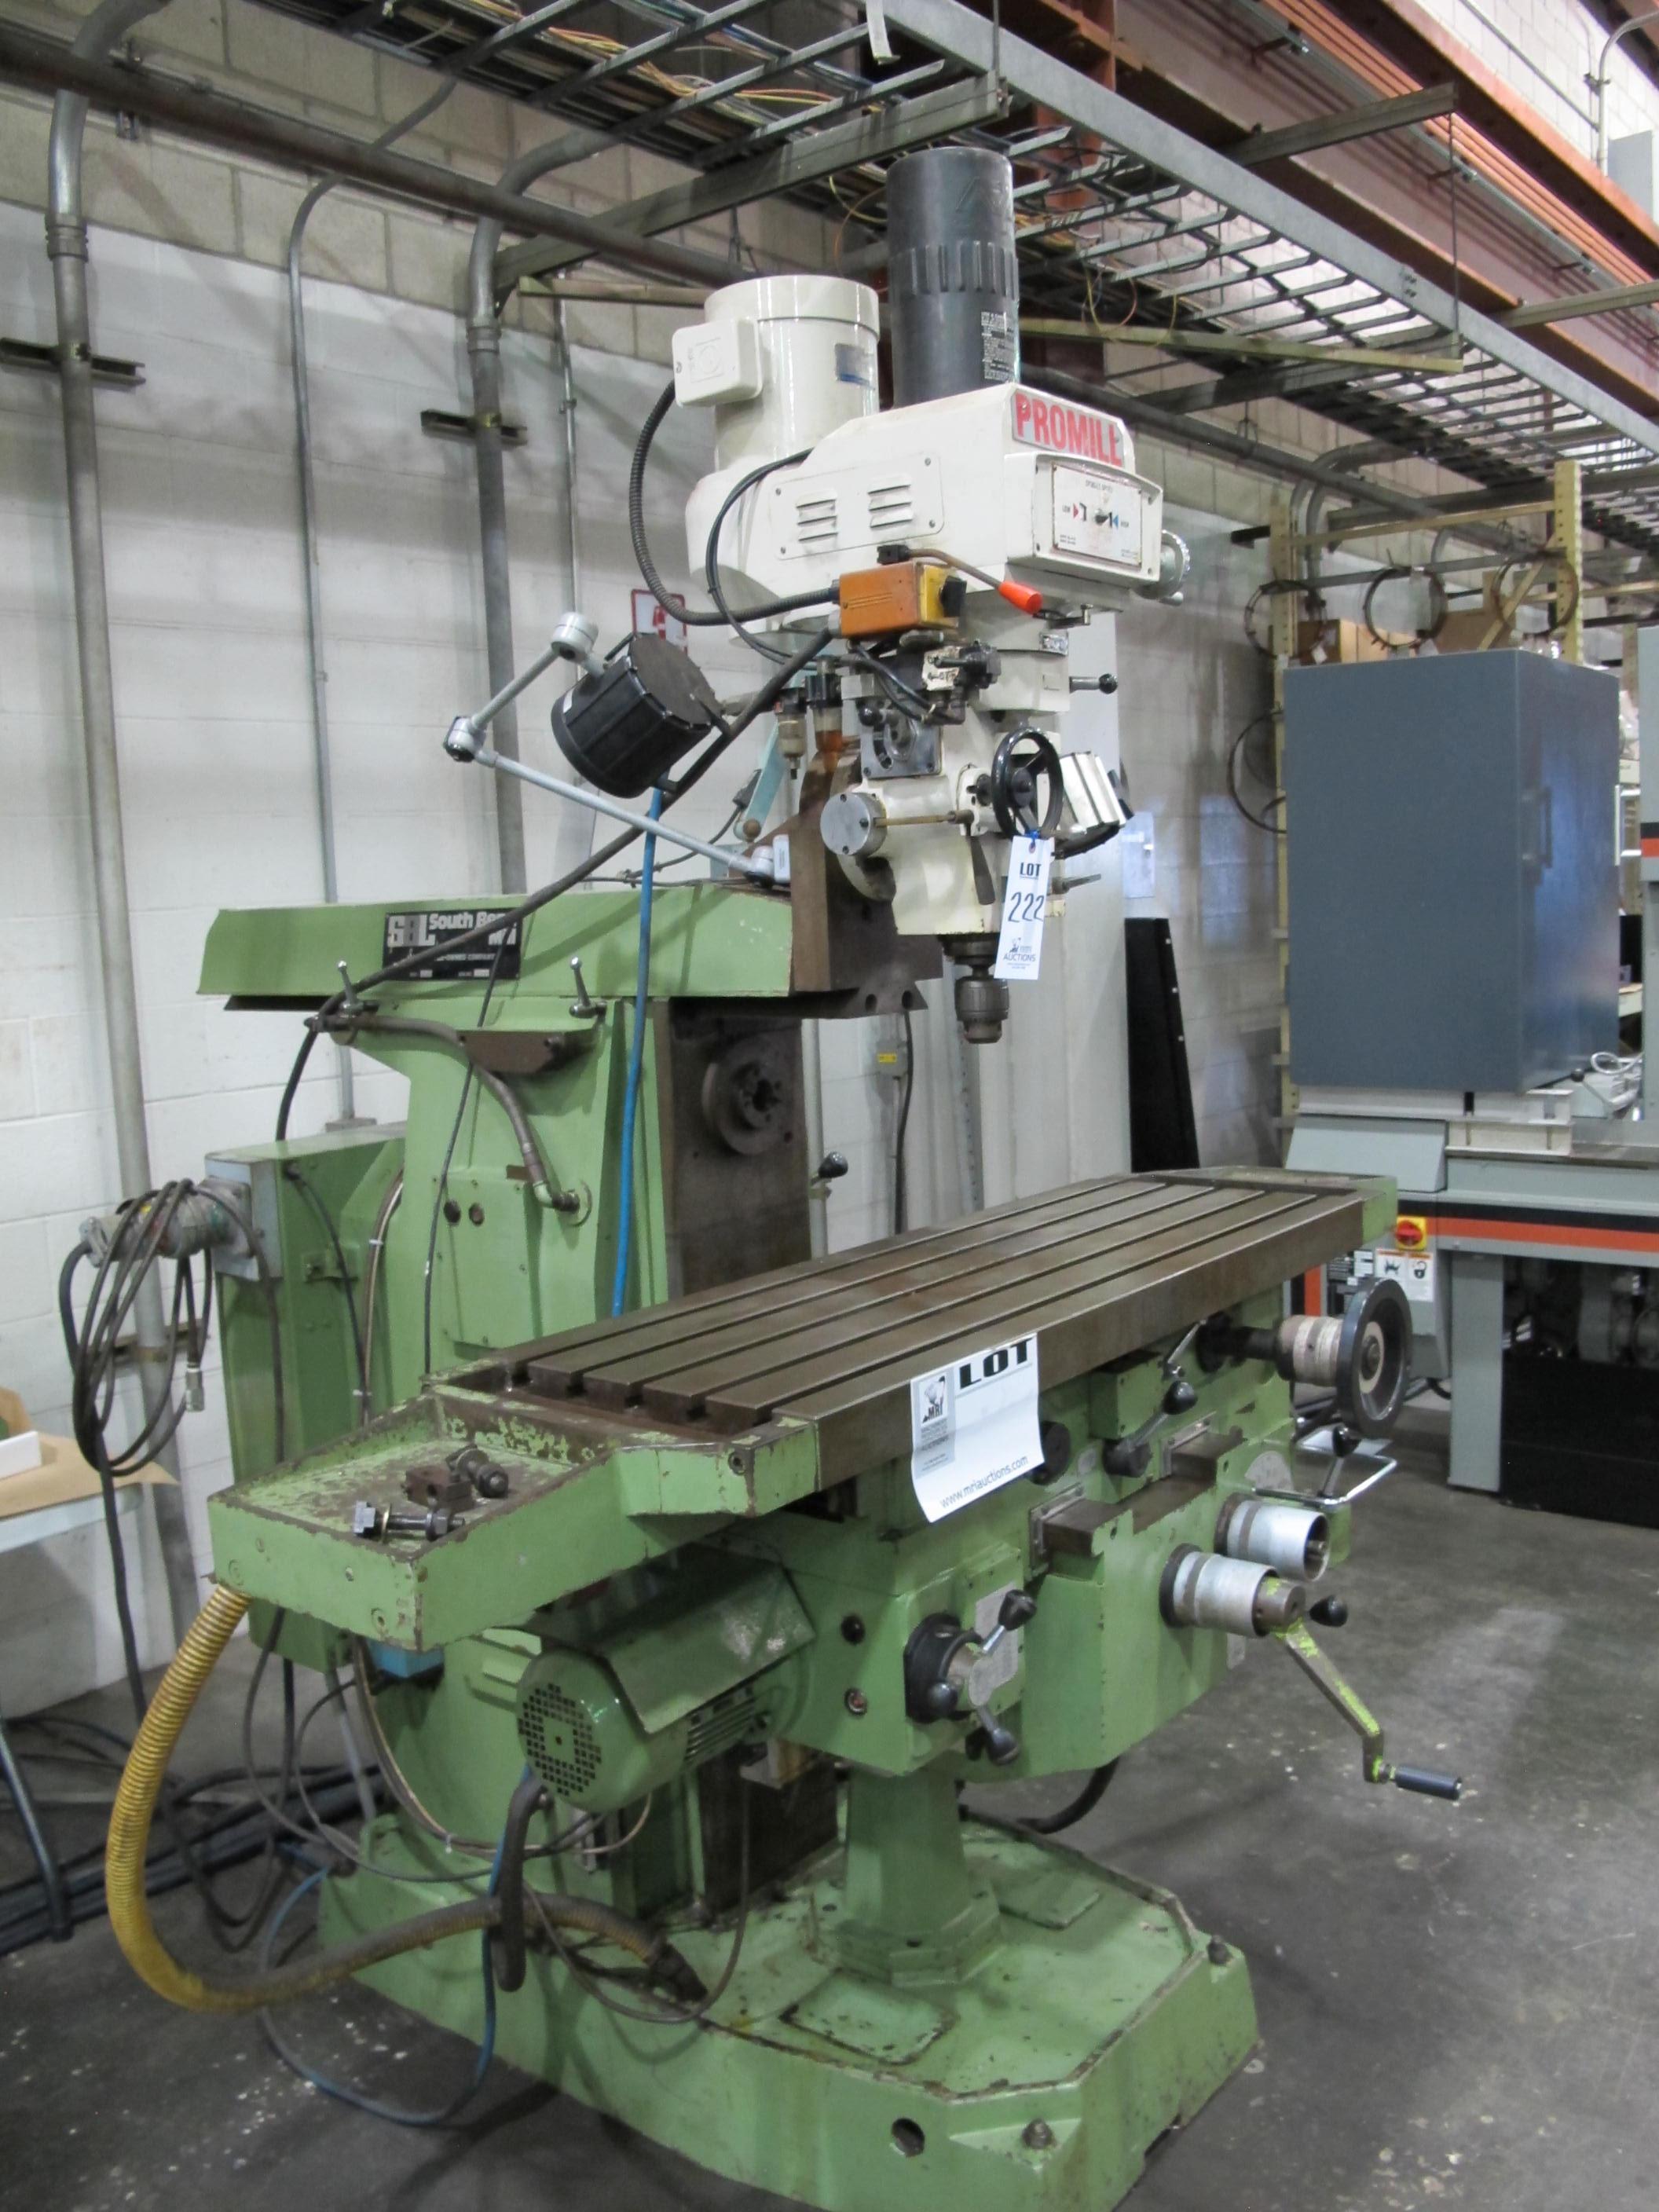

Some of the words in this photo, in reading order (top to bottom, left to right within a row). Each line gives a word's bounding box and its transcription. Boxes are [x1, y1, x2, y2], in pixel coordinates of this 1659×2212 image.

[1016, 394, 1122, 466] PROMILL
[1020, 862, 1042, 877] LOT
[429, 912, 473, 930] South
[1008, 892, 1046, 923] 222
[1003, 954, 1036, 962] AUCTIONS
[959, 1338, 1033, 1389] LOT
[939, 1455, 1029, 1509] www.mriauctions.com
